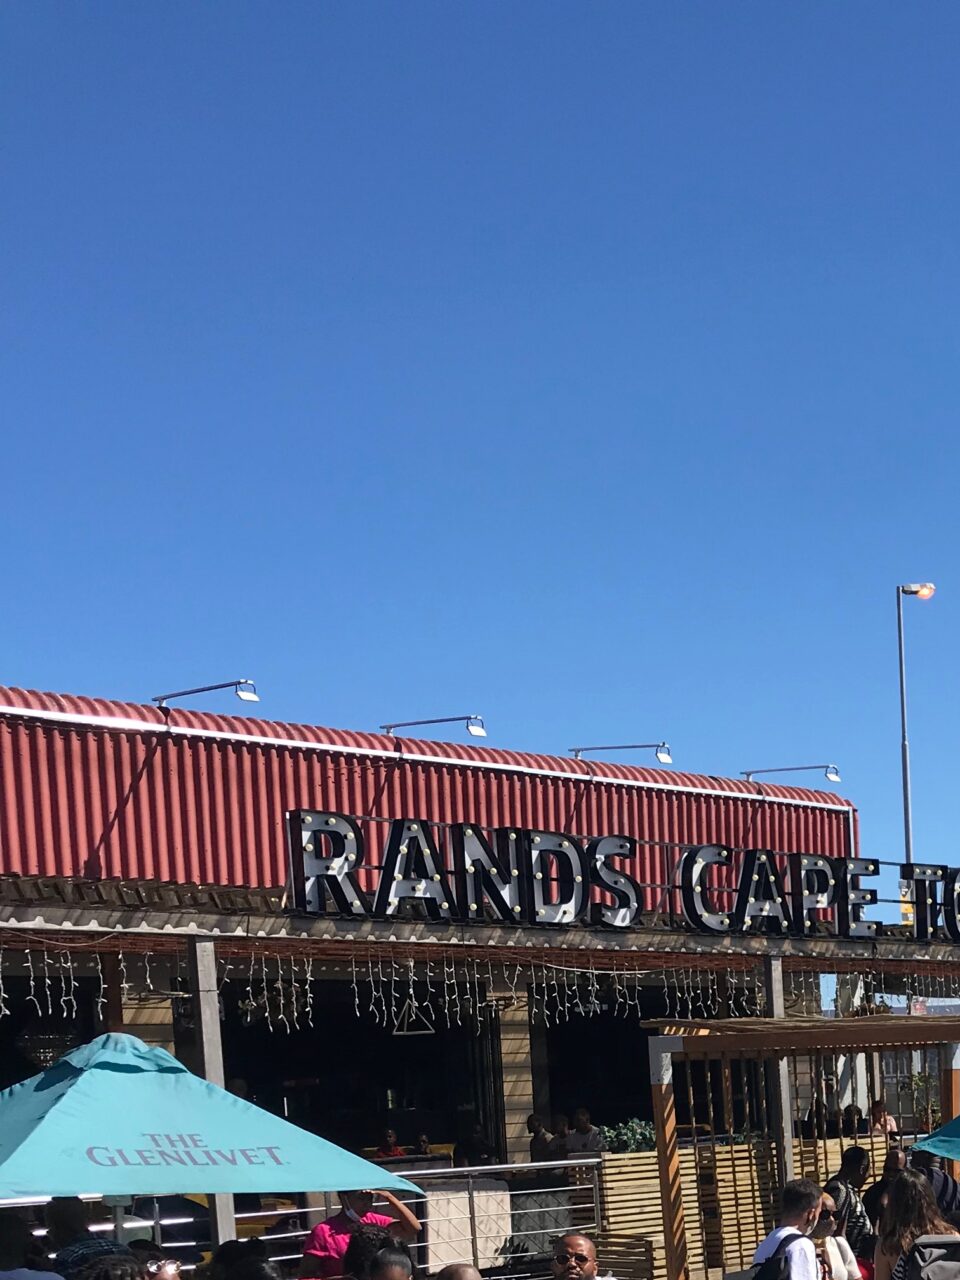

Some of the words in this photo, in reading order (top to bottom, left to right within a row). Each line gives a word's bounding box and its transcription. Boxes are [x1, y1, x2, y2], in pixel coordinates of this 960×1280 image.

[286, 809, 643, 928] RANDS
[680, 843, 883, 937] CAPE
[141, 1133, 208, 1149] THE
[85, 1146, 288, 1167] GLENLIVET
